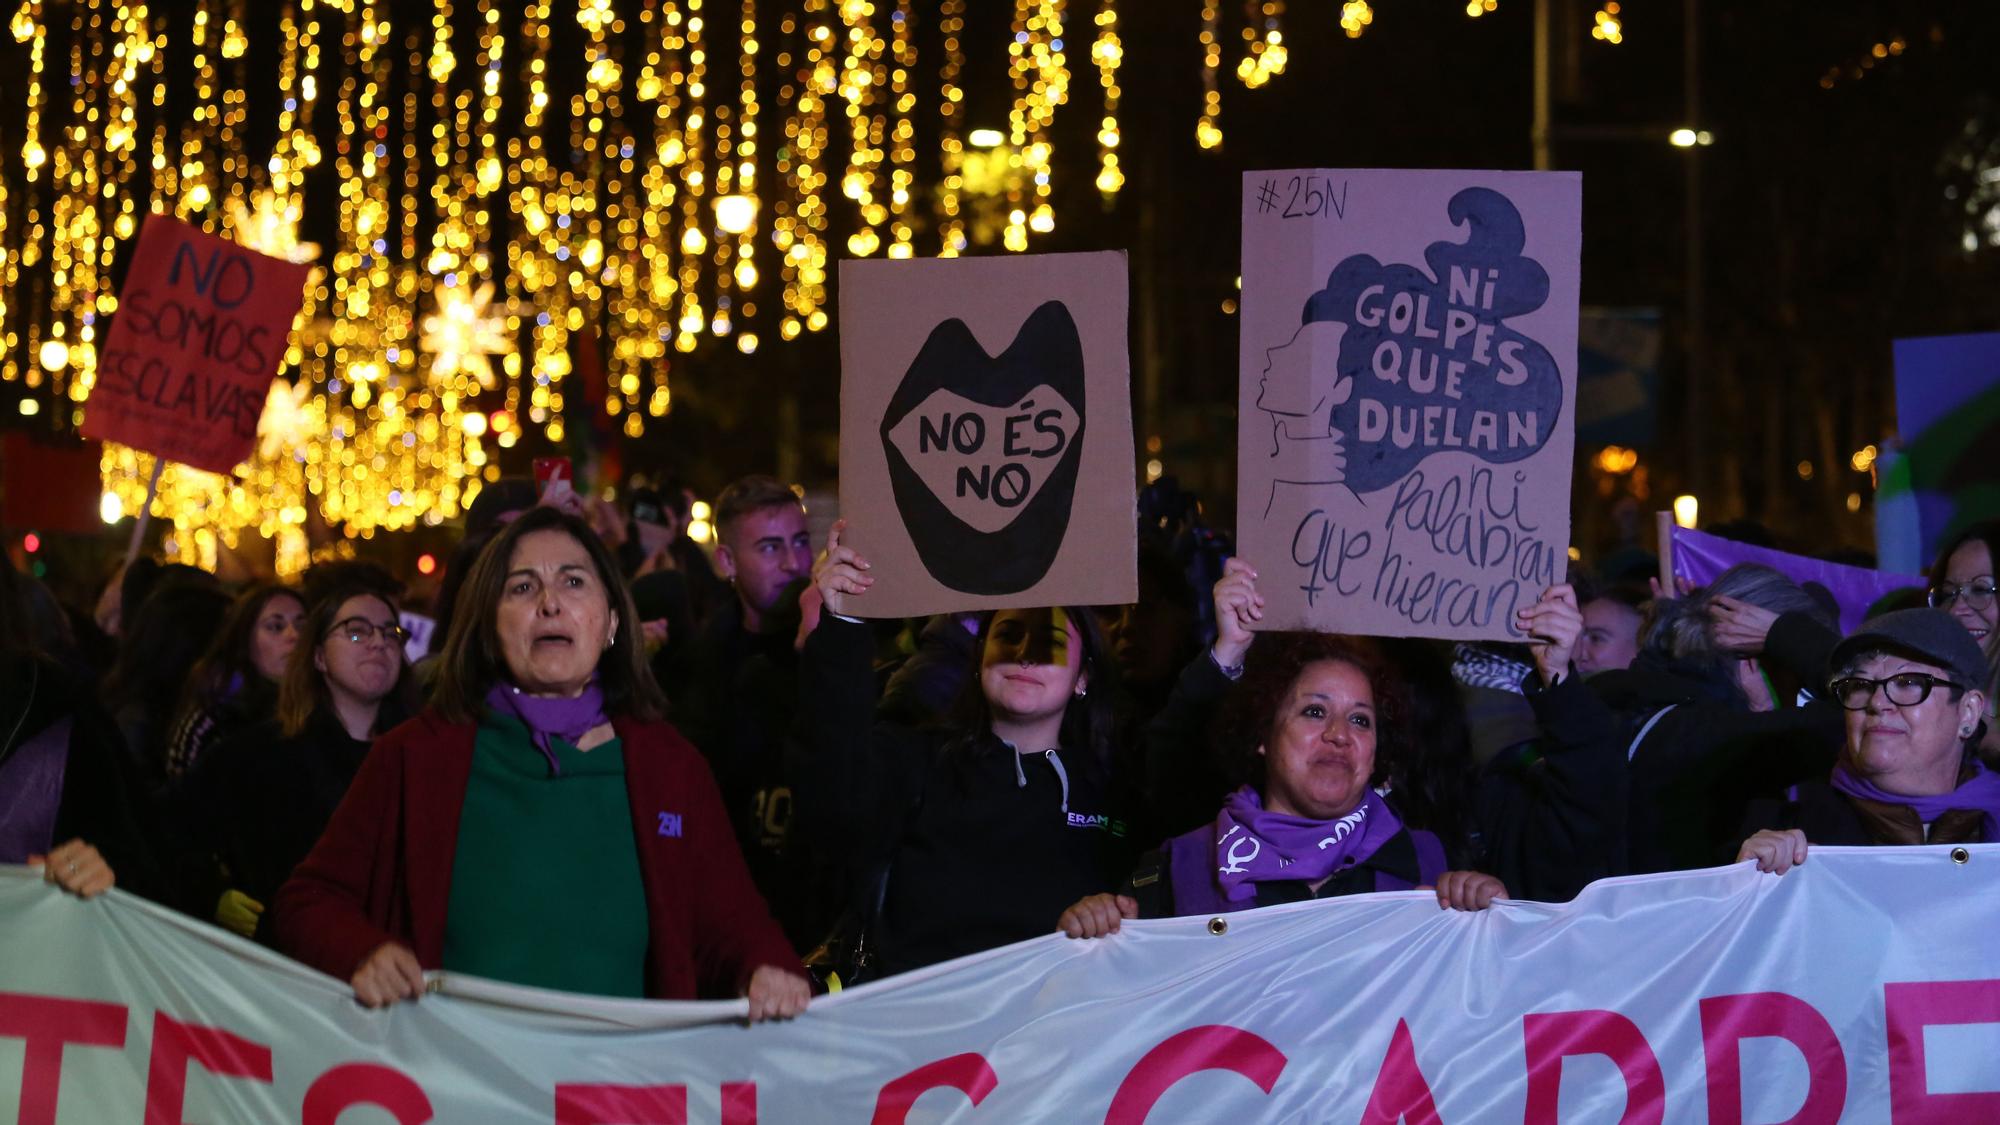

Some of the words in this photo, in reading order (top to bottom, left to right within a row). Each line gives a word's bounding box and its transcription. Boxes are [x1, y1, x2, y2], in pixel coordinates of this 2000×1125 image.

[1256, 176, 1348, 221] #25N
[168, 240, 255, 310] NO
[125, 287, 273, 376] SOMOS
[1354, 283, 1529, 387] GOLPES
[99, 350, 265, 440] ESCLAVAS
[1371, 339, 1467, 400] QUE
[1003, 399, 1067, 459] ÉS
[1357, 398, 1538, 450] DUELAN
[1373, 523, 1523, 637] hieran
